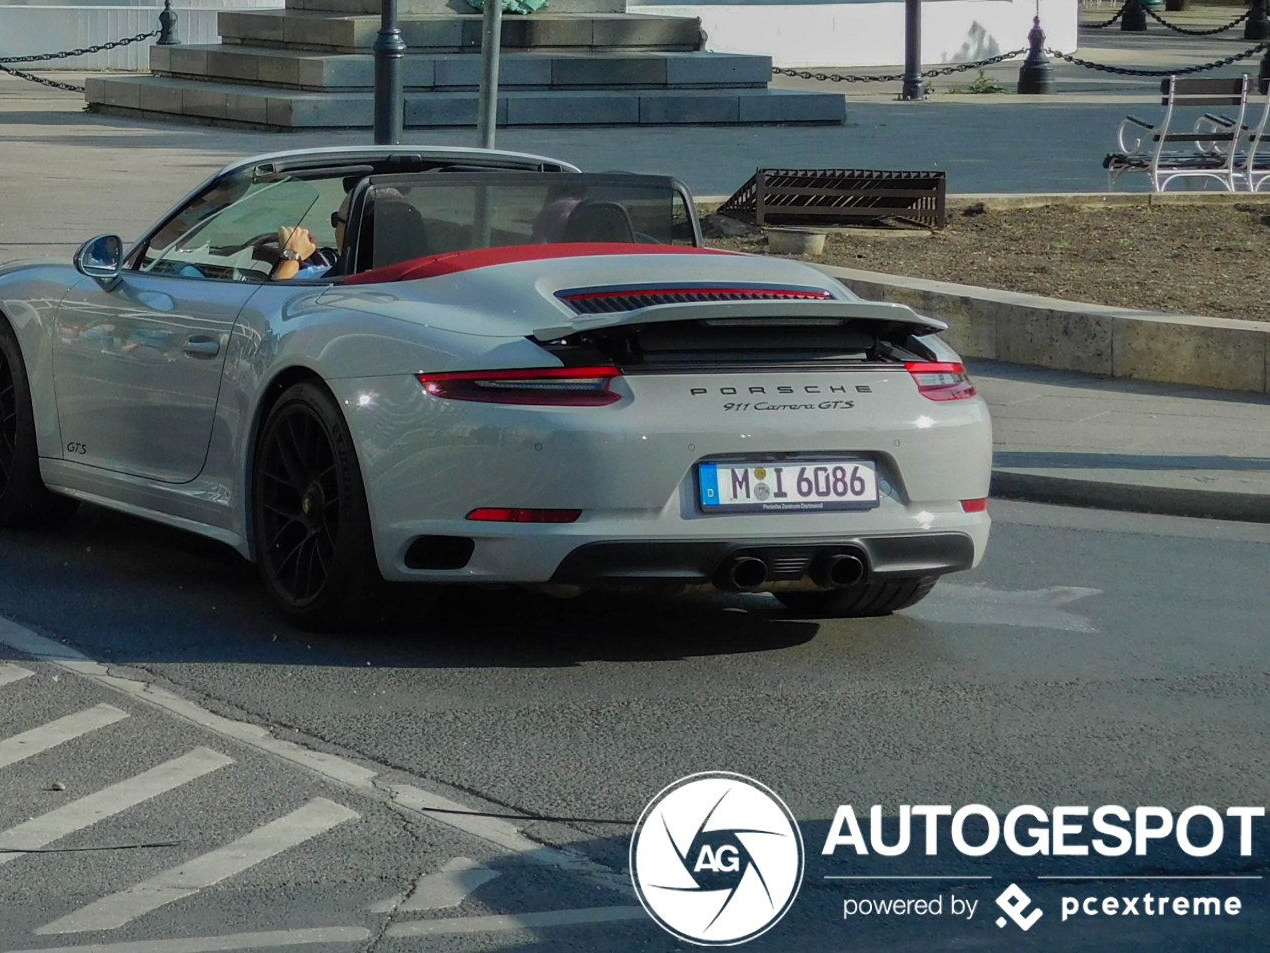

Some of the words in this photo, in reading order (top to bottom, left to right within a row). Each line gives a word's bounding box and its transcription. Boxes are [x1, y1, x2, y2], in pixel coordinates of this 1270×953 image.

[689, 385, 873, 396] PORSCHE
[723, 402, 752, 412] 911
[753, 401, 816, 411] Carrera
[818, 400, 855, 410] GTS
[66, 441, 87, 455] GTS
[707, 488, 714, 498] D
